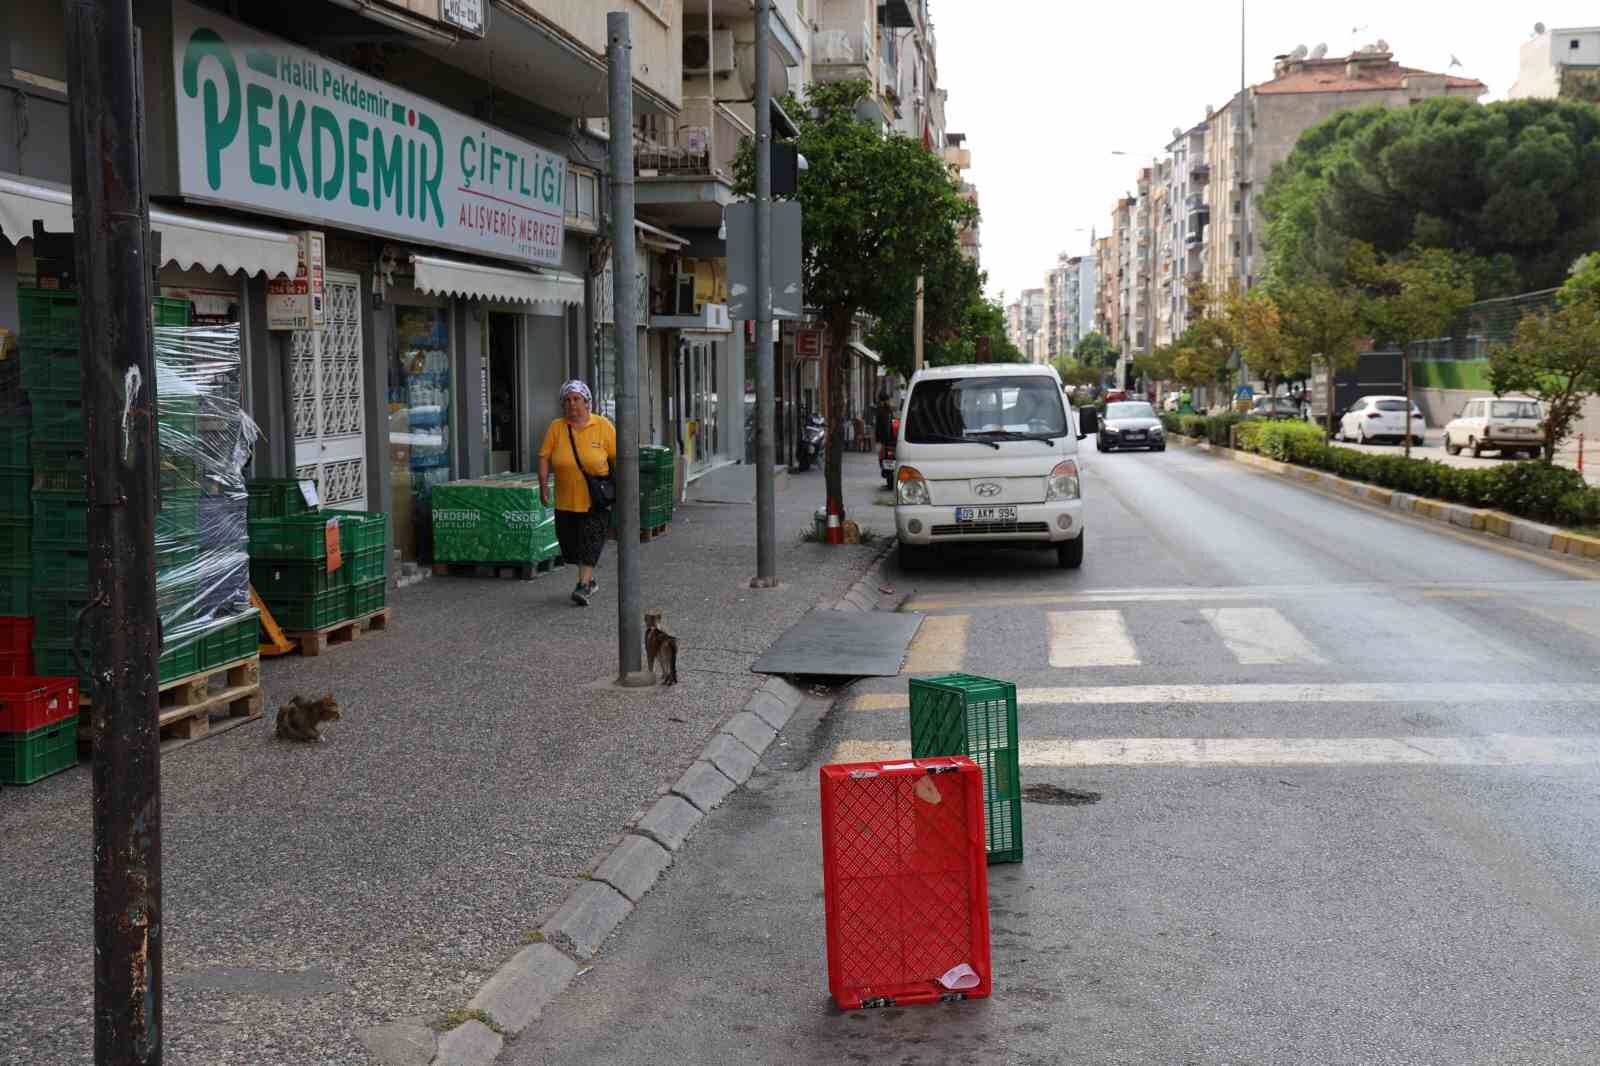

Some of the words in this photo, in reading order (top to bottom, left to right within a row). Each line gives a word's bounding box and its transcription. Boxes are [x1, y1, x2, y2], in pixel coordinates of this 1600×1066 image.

[280, 55, 319, 94] Halil
[321, 68, 390, 118] Pekdemir
[460, 130, 563, 206] ÇİFTLİĞİ
[459, 203, 516, 243] ALIŞVERİŞ
[977, 507, 994, 518] AKM
